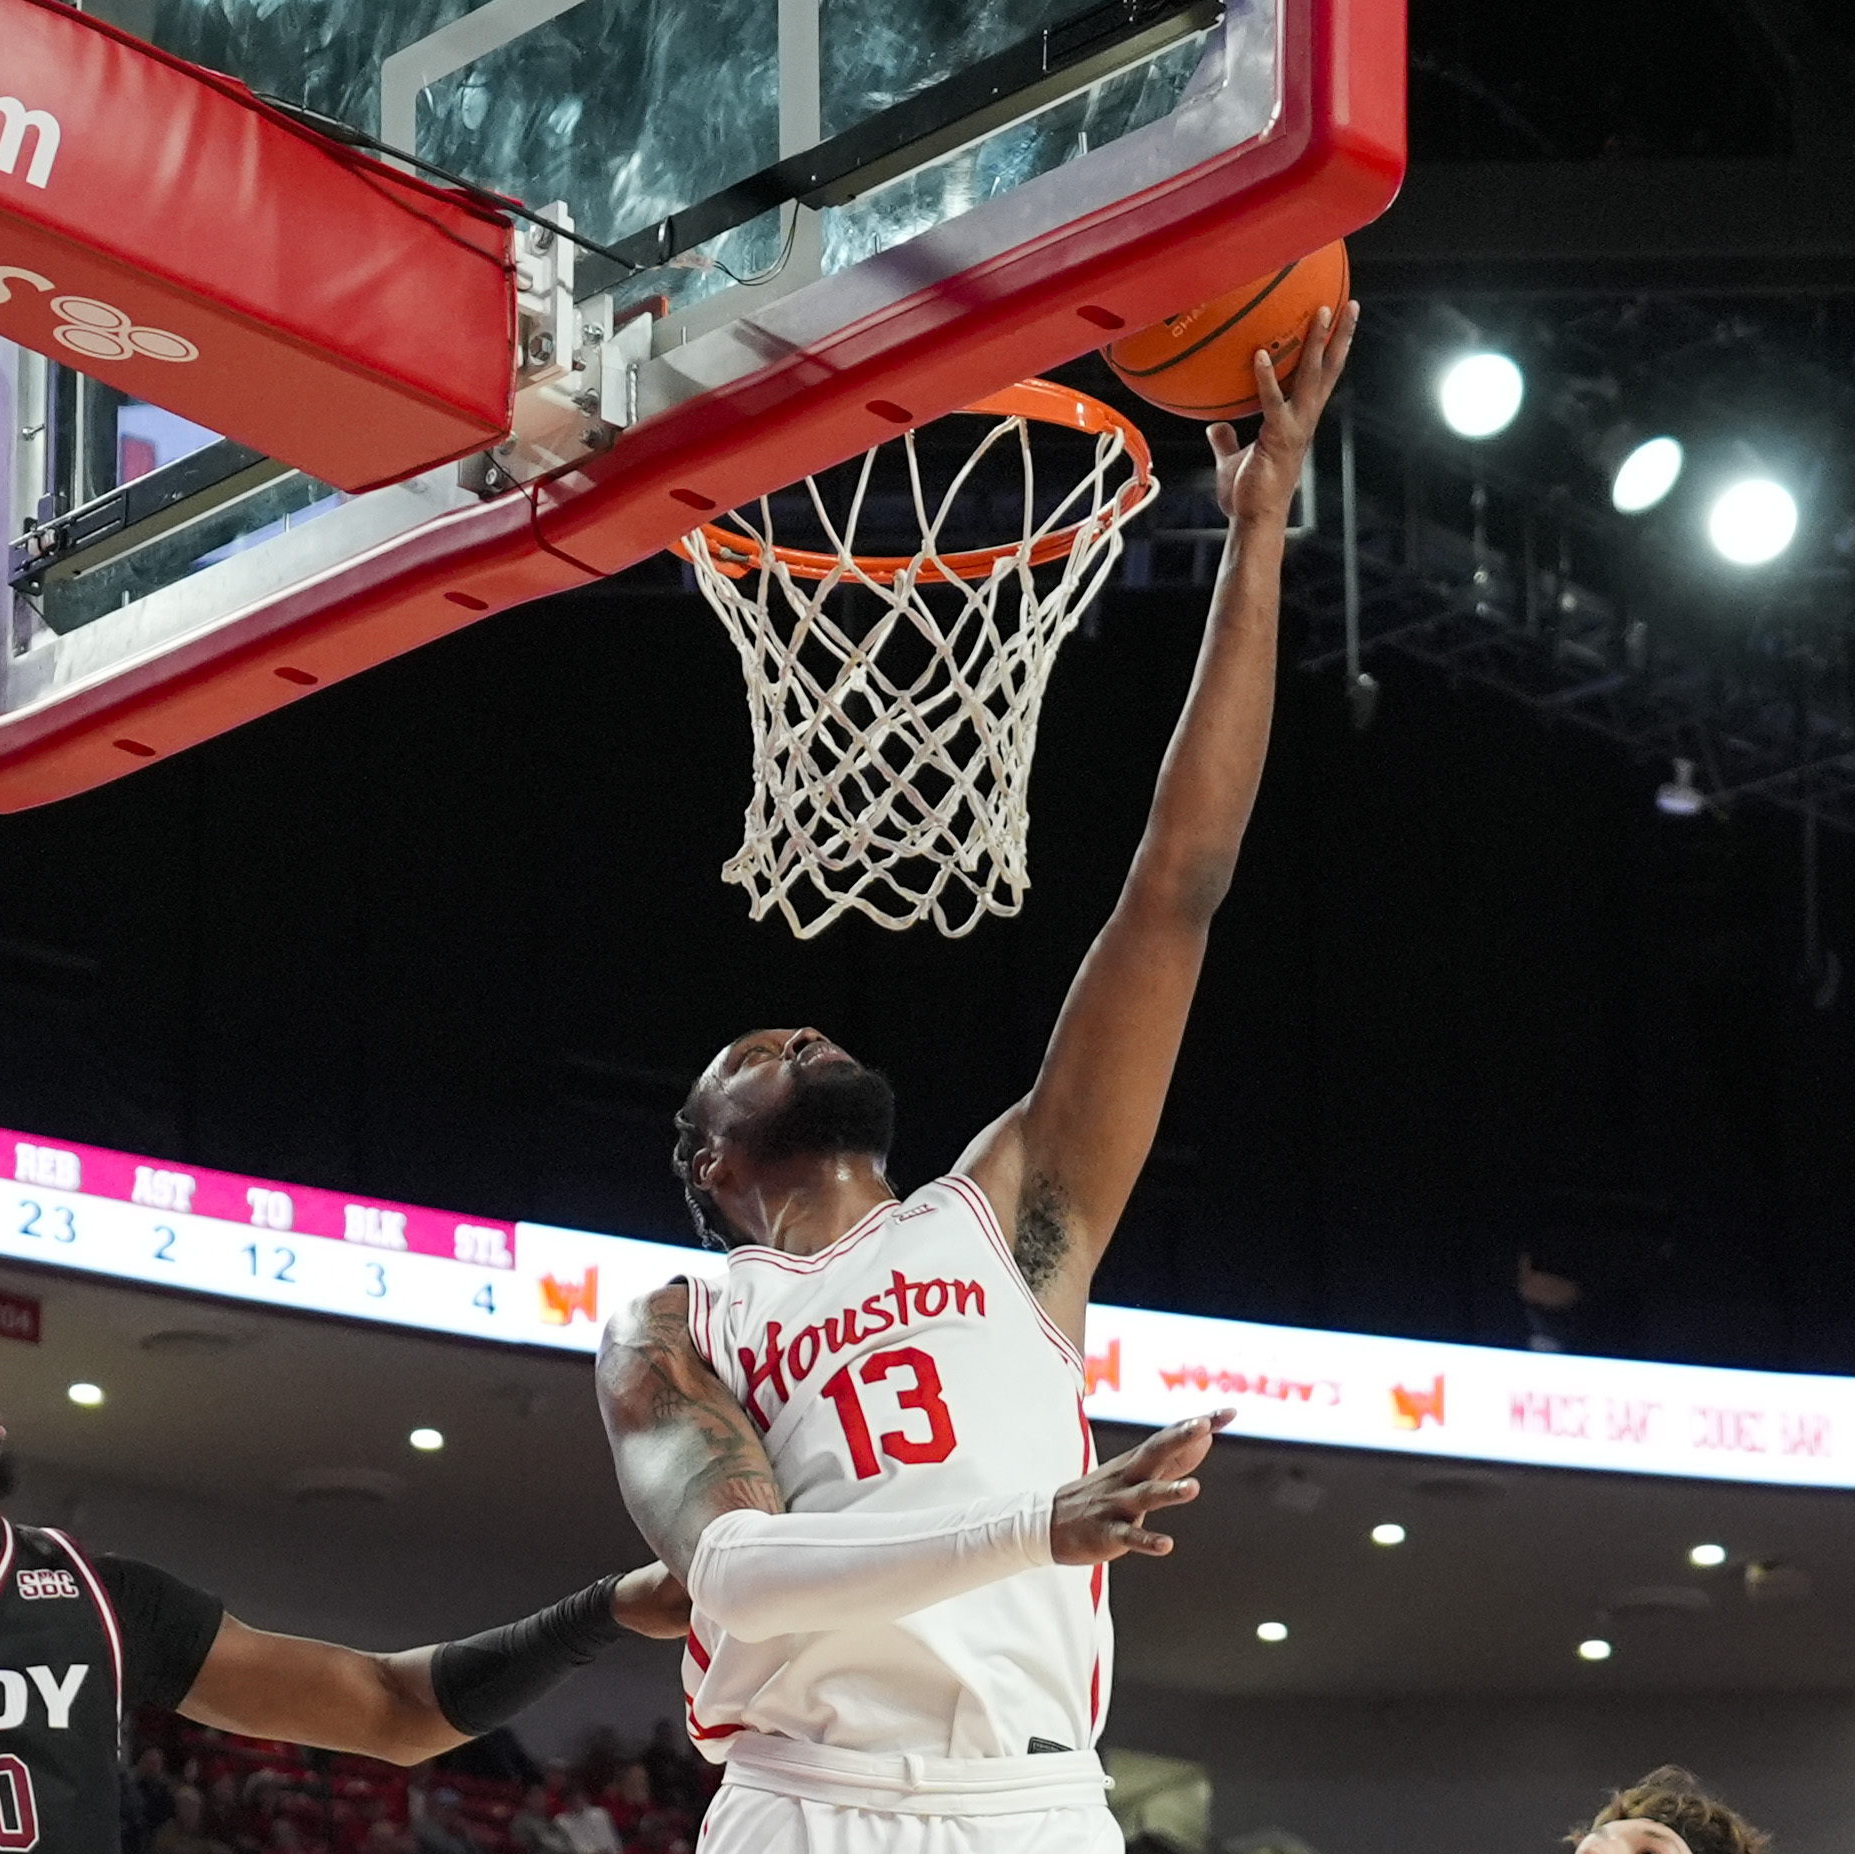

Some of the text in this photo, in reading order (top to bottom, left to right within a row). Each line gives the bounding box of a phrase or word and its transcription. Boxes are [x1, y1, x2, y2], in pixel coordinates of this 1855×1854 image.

[13, 1142, 82, 1193] REB
[131, 1164, 197, 1214] AST
[246, 1186, 297, 1232] TO
[343, 1203, 408, 1252] BLK
[453, 1223, 514, 1270] STL
[18, 1199, 77, 1244] 23
[152, 1224, 177, 1263] 2
[241, 1241, 296, 1284] 12
[364, 1261, 388, 1298] 3
[471, 1281, 498, 1316] 4
[737, 1269, 987, 1433] Houston
[821, 1346, 957, 1479] 13
[16, 1569, 80, 1600] SBC
